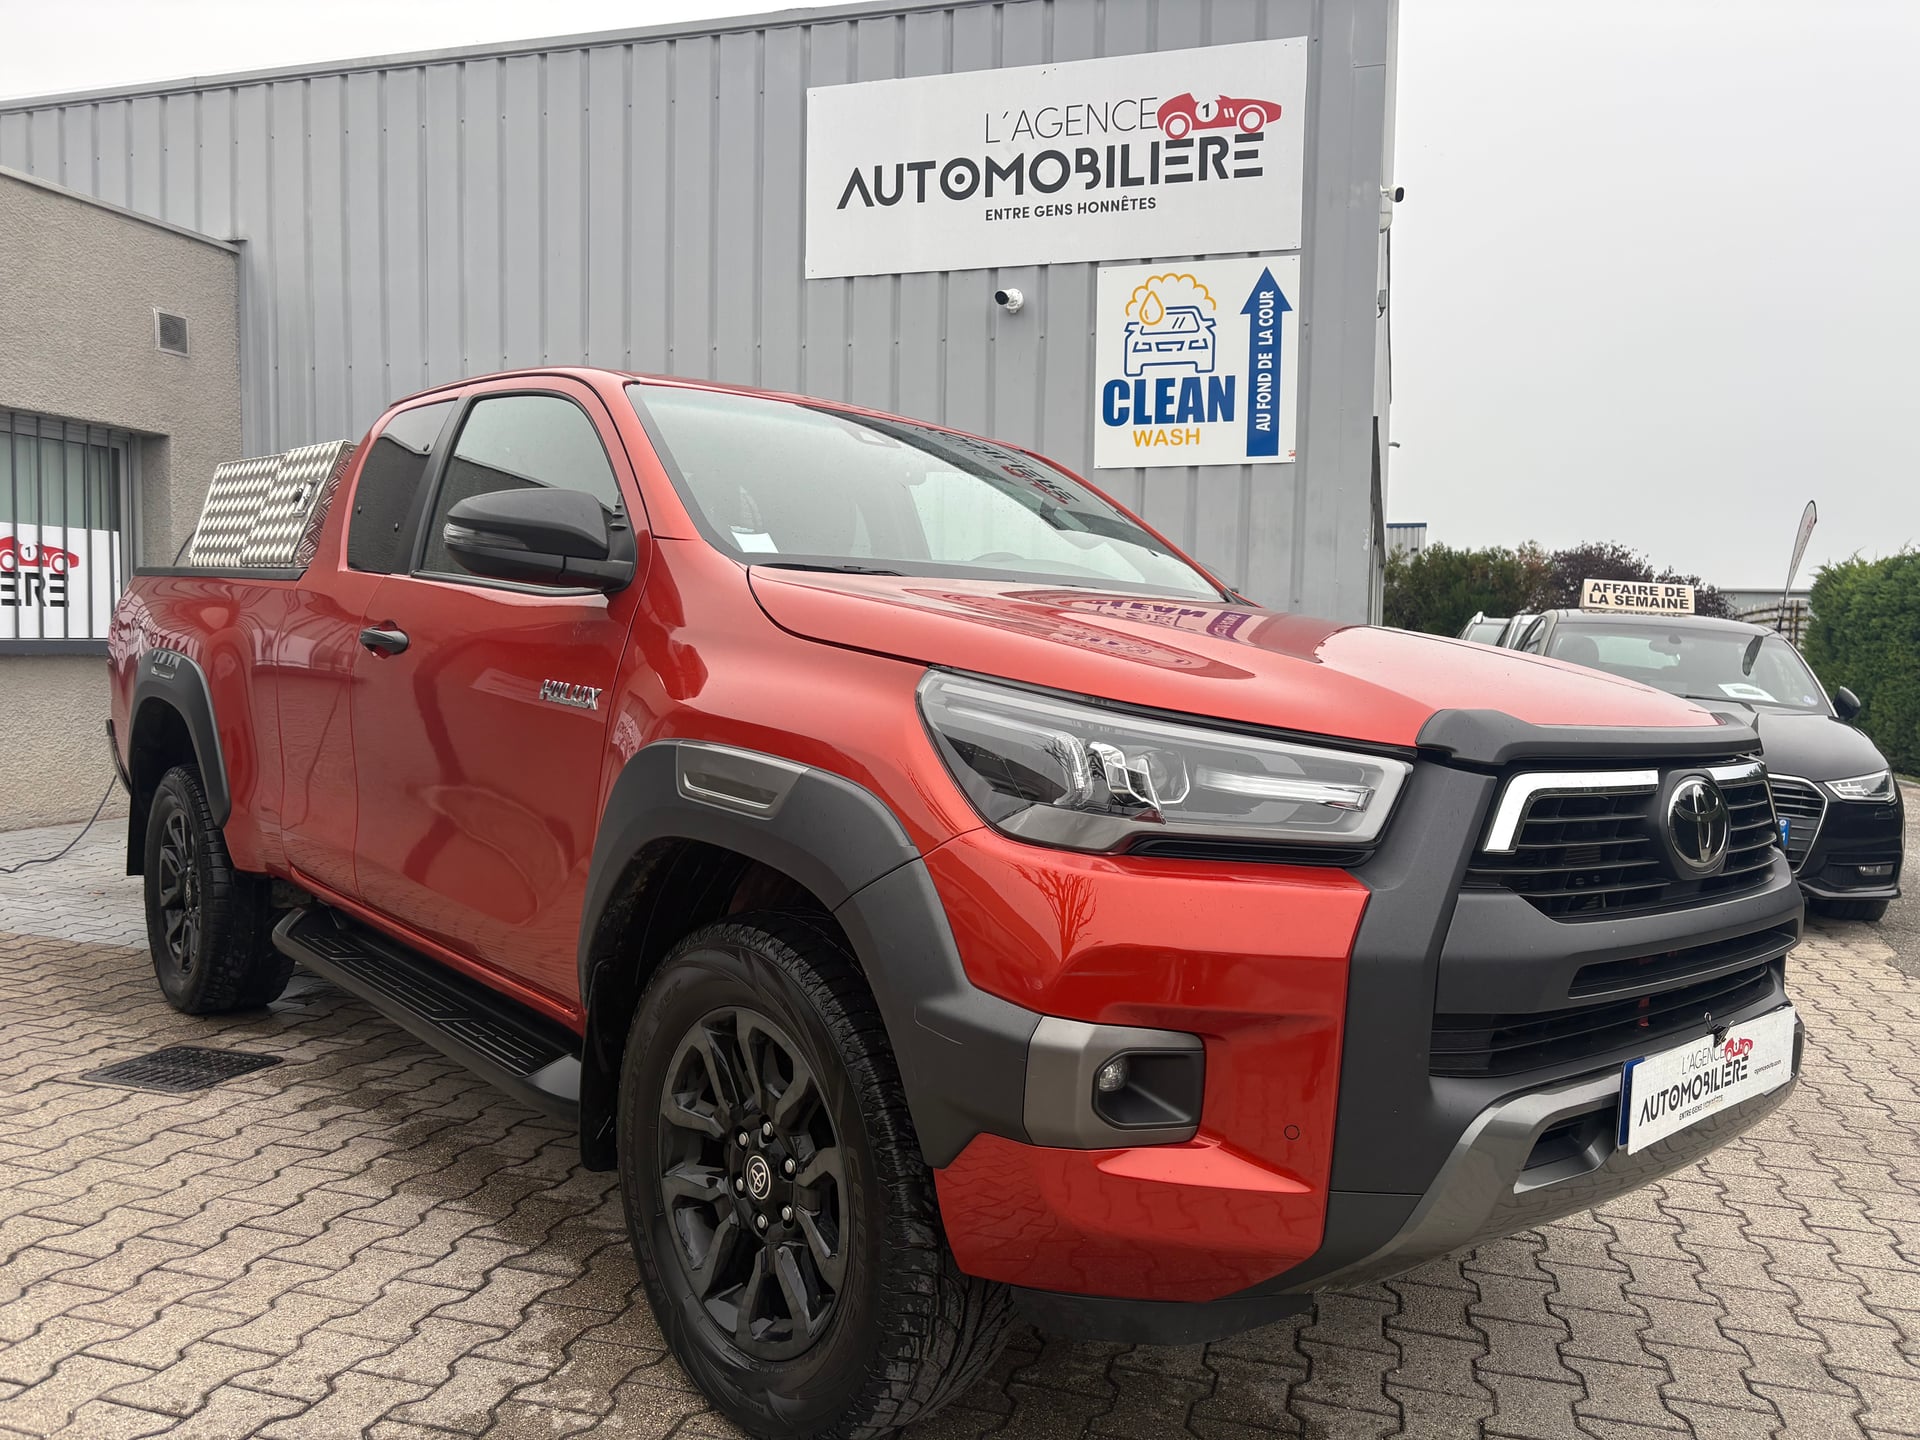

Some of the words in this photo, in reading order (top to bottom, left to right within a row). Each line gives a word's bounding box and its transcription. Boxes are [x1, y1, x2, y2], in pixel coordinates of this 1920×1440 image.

[985, 97, 1158, 144] L'AGENCE
[985, 207, 1030, 221] ENTRE
[1034, 203, 1073, 217] GENS
[1077, 195, 1157, 214] HONNÊTES
[1259, 290, 1274, 327] COUR
[1258, 329, 1273, 345] LA
[1258, 352, 1273, 371] DE
[1102, 375, 1236, 427] CLEAN
[1256, 372, 1272, 409] FOND
[1256, 413, 1271, 432] AU
[1132, 427, 1200, 447] WASH
[1589, 593, 1609, 605] LA
[1614, 594, 1689, 610] SEMAINE
[1591, 582, 1659, 597] AFFAIRE
[1664, 586, 1686, 598] DE
[539, 678, 602, 710] HILUX
